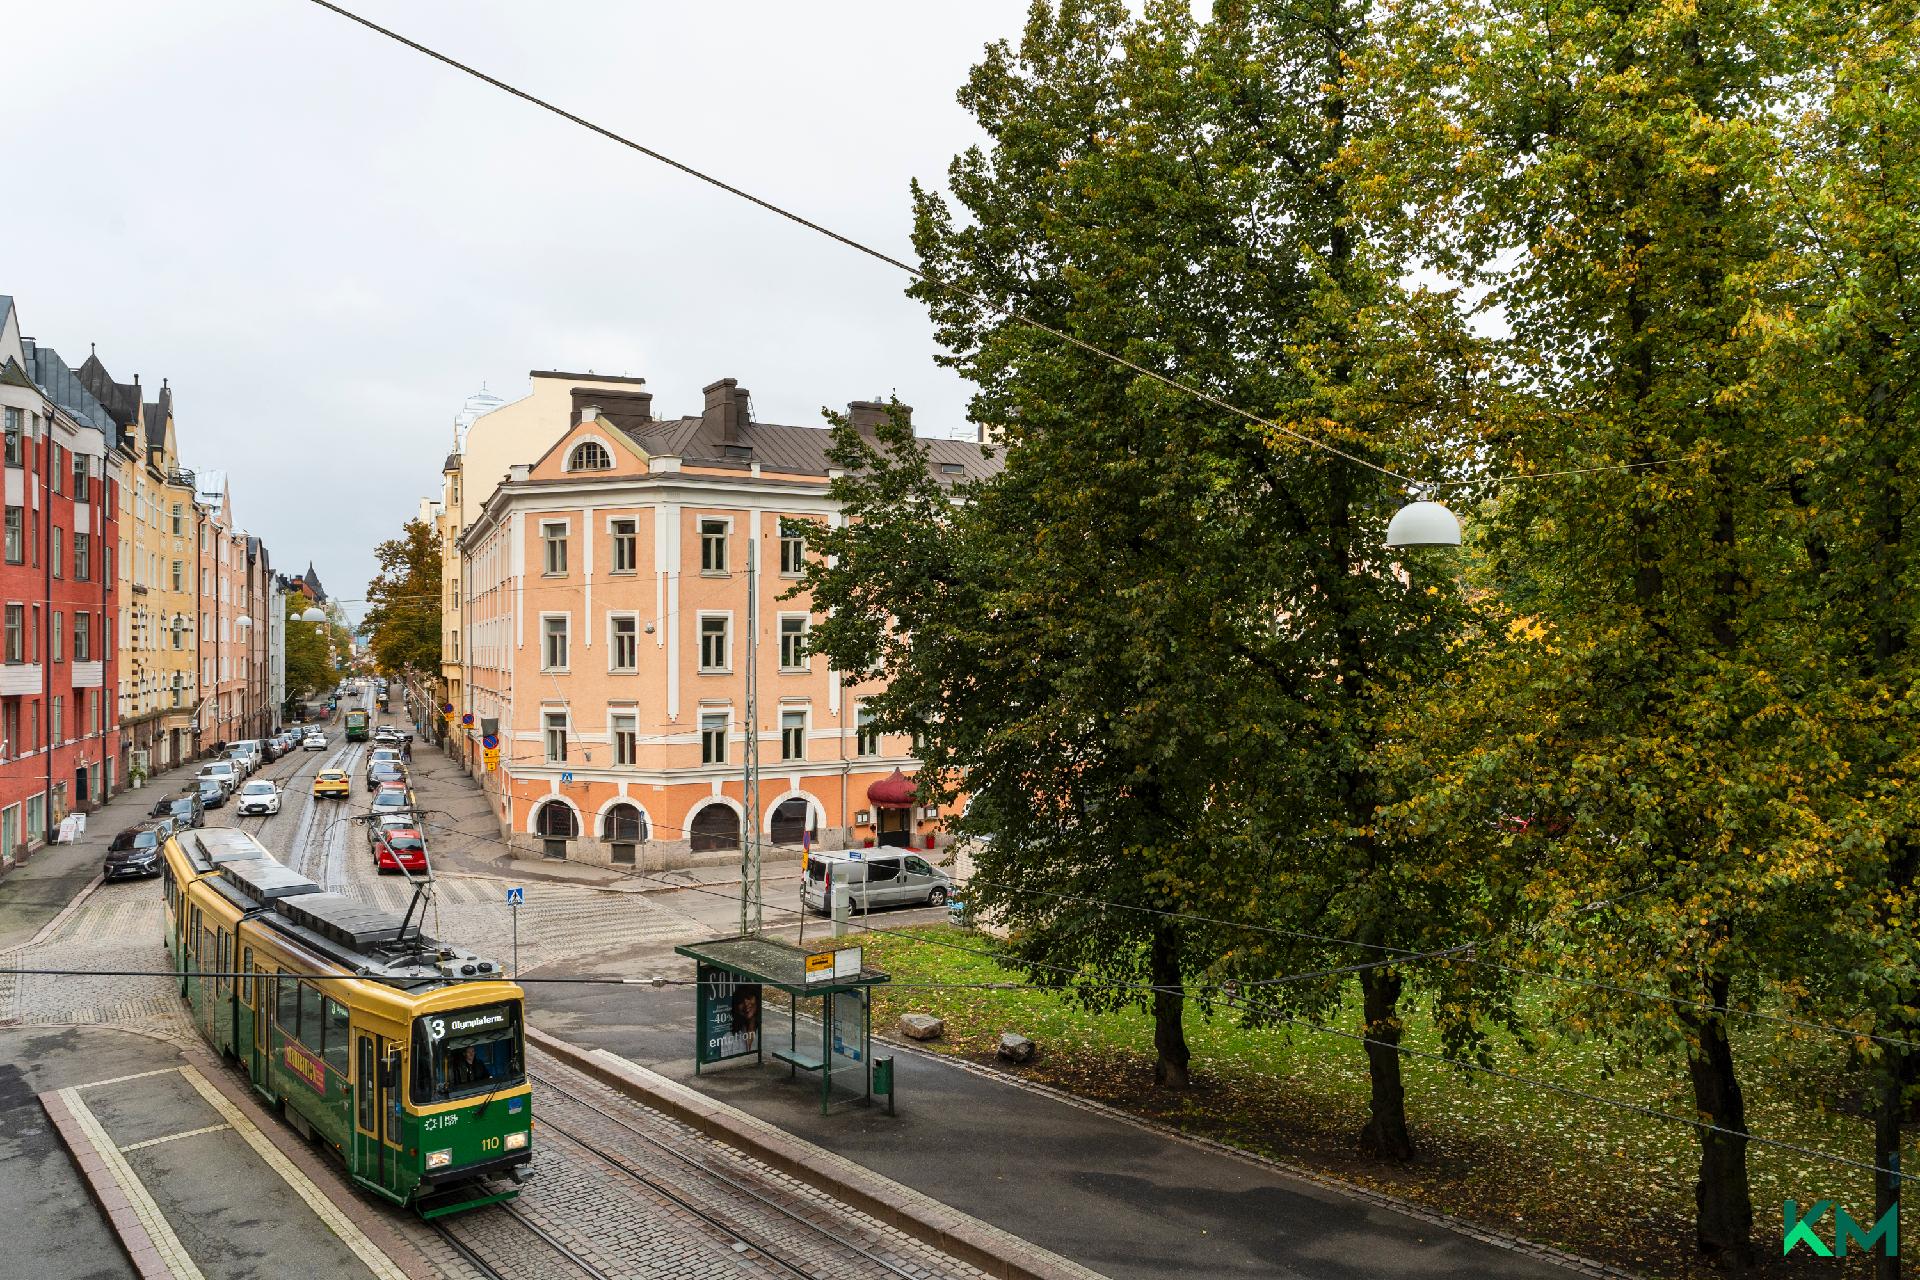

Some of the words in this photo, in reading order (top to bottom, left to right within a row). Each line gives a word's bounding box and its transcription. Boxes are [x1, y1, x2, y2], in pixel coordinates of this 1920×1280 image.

[432, 1019, 446, 1039] 3
[451, 1015, 504, 1030] Olympiaterm.
[709, 1031, 756, 1048] emotion
[481, 1137, 500, 1151] 110
